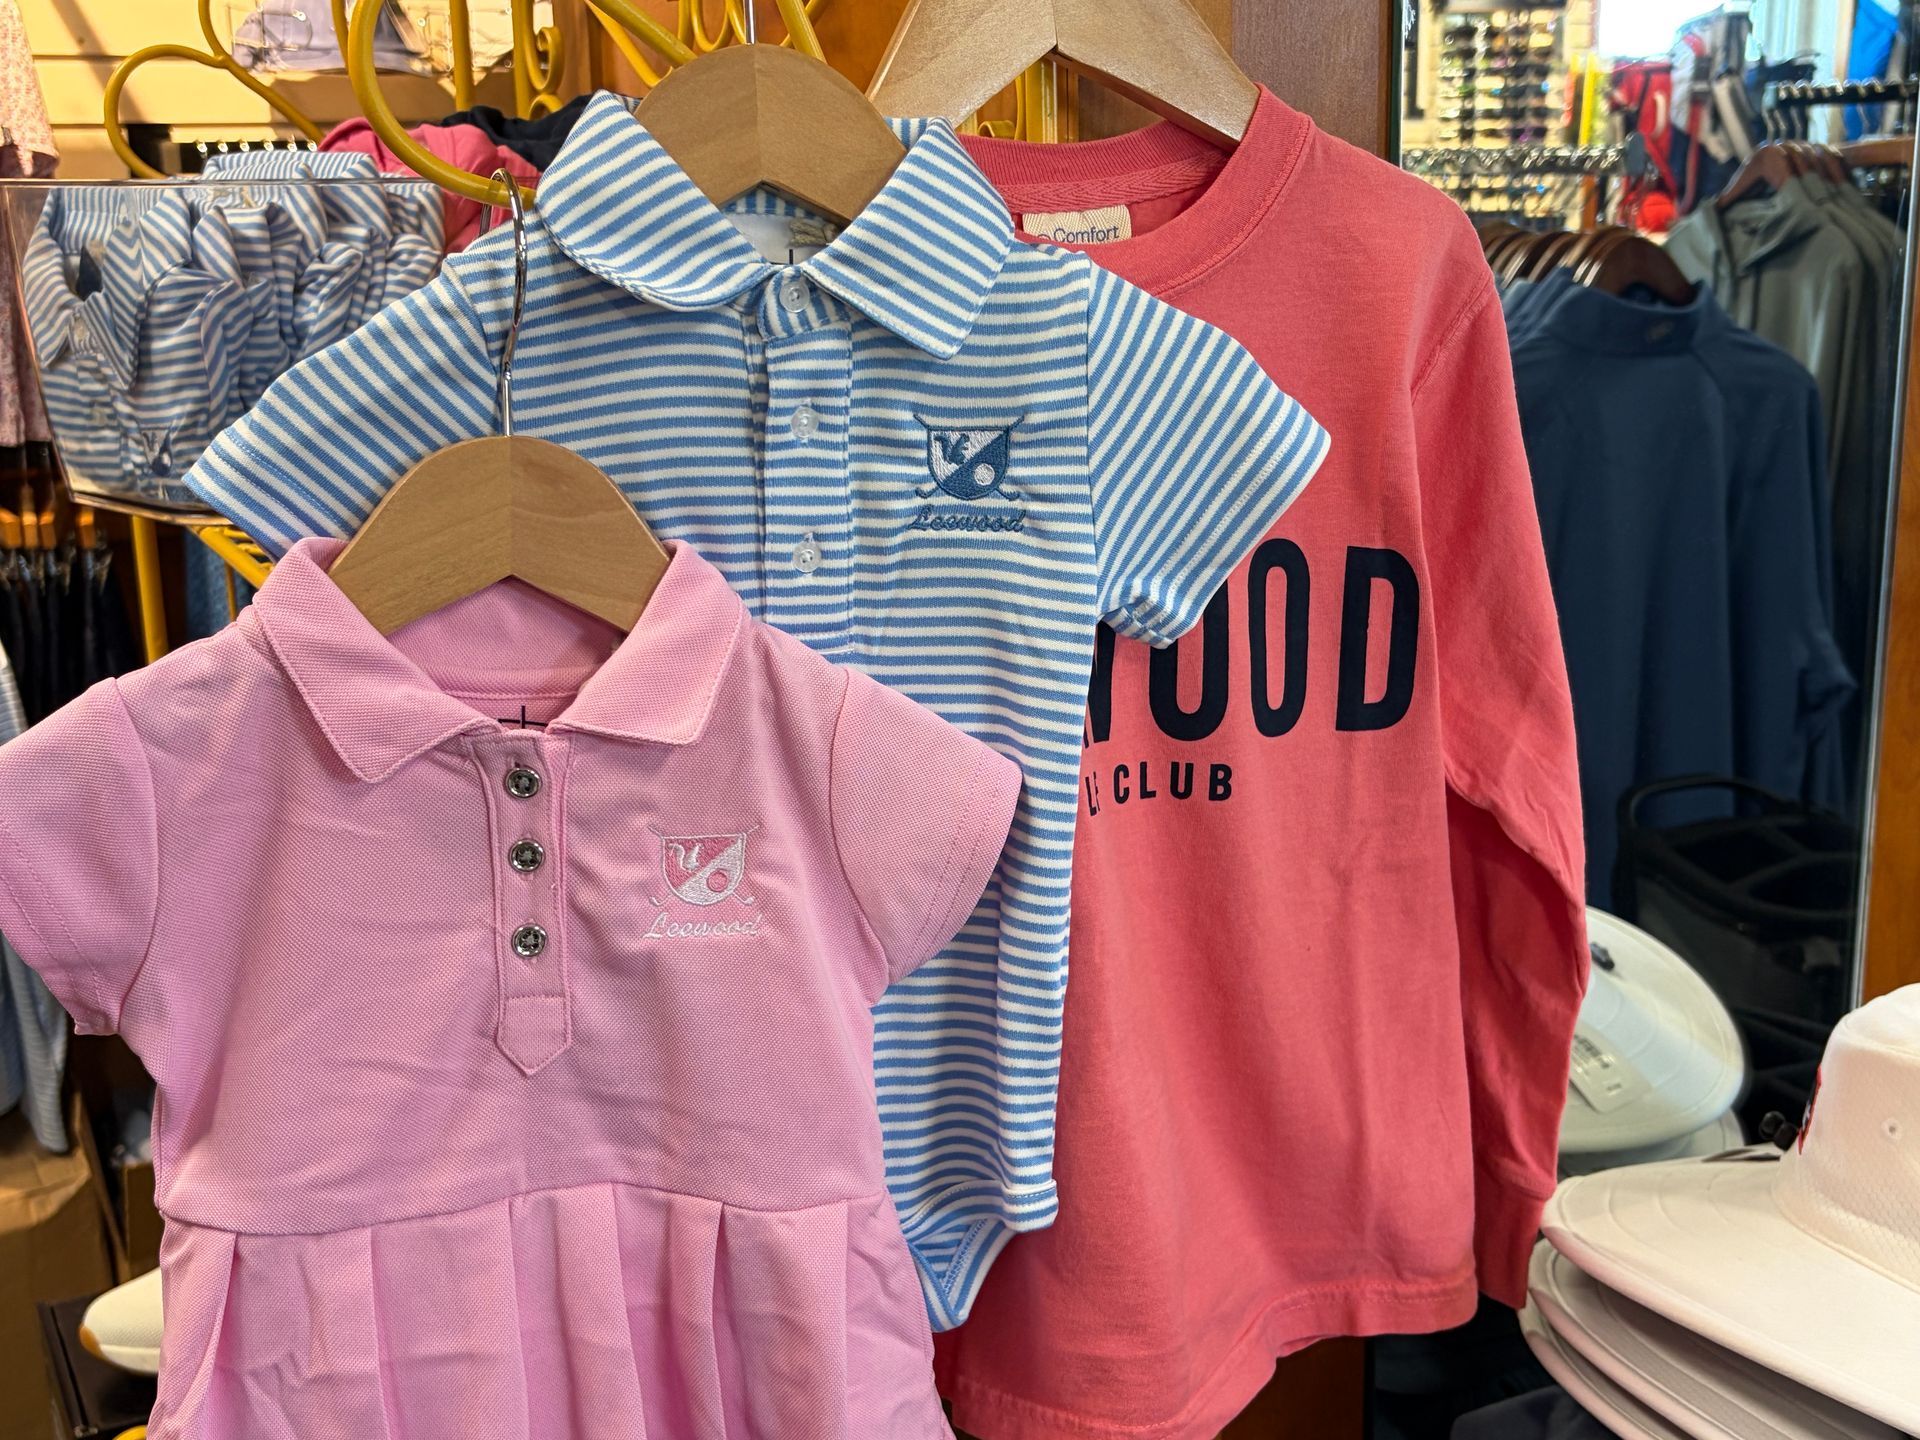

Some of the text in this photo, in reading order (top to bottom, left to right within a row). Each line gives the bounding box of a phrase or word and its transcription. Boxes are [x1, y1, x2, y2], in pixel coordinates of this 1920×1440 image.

[1053, 225, 1120, 244] Comfort
[907, 504, 1027, 533] Leewood
[1113, 761, 1233, 805] CLUB
[642, 912, 763, 939] Leewood
